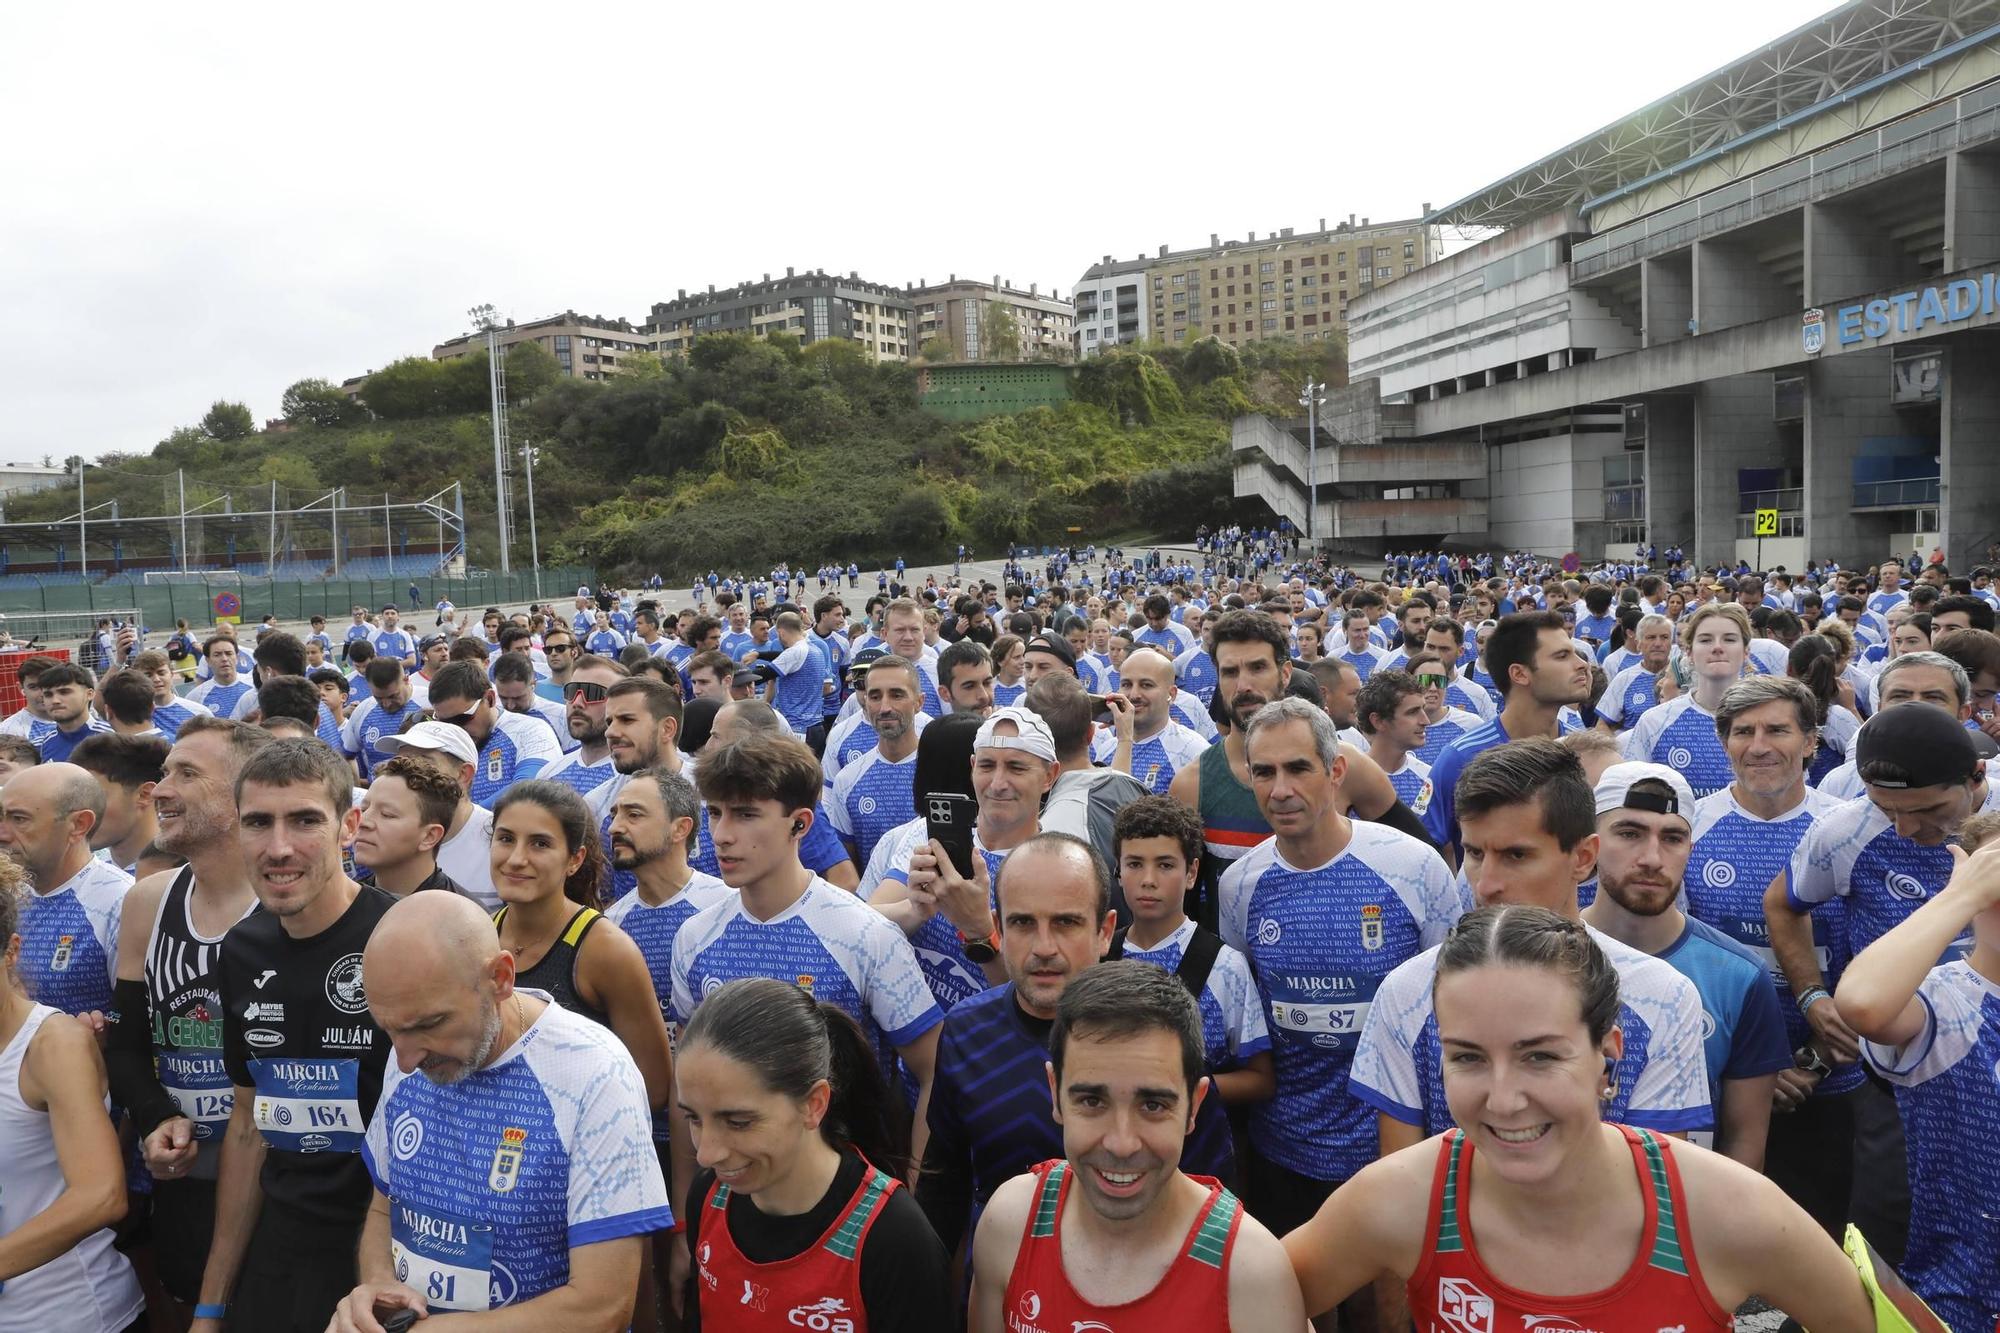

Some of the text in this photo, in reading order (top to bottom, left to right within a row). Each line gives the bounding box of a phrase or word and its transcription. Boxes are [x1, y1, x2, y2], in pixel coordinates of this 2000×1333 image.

[1758, 512, 1774, 530] P2
[1286, 976, 1356, 990] MARCHA
[1328, 1010, 1356, 1029] 87
[322, 1025, 373, 1044] JULIÁN
[168, 1059, 226, 1074] MARCHA
[272, 1064, 340, 1080] MARCHA
[195, 1094, 234, 1117] 128
[307, 1106, 348, 1127] 164
[486, 1200, 522, 1213] MUROS
[524, 1204, 540, 1213] DE
[402, 1207, 468, 1245] MARCHA
[427, 1270, 456, 1302] 81
[788, 1308, 854, 1333] coa
